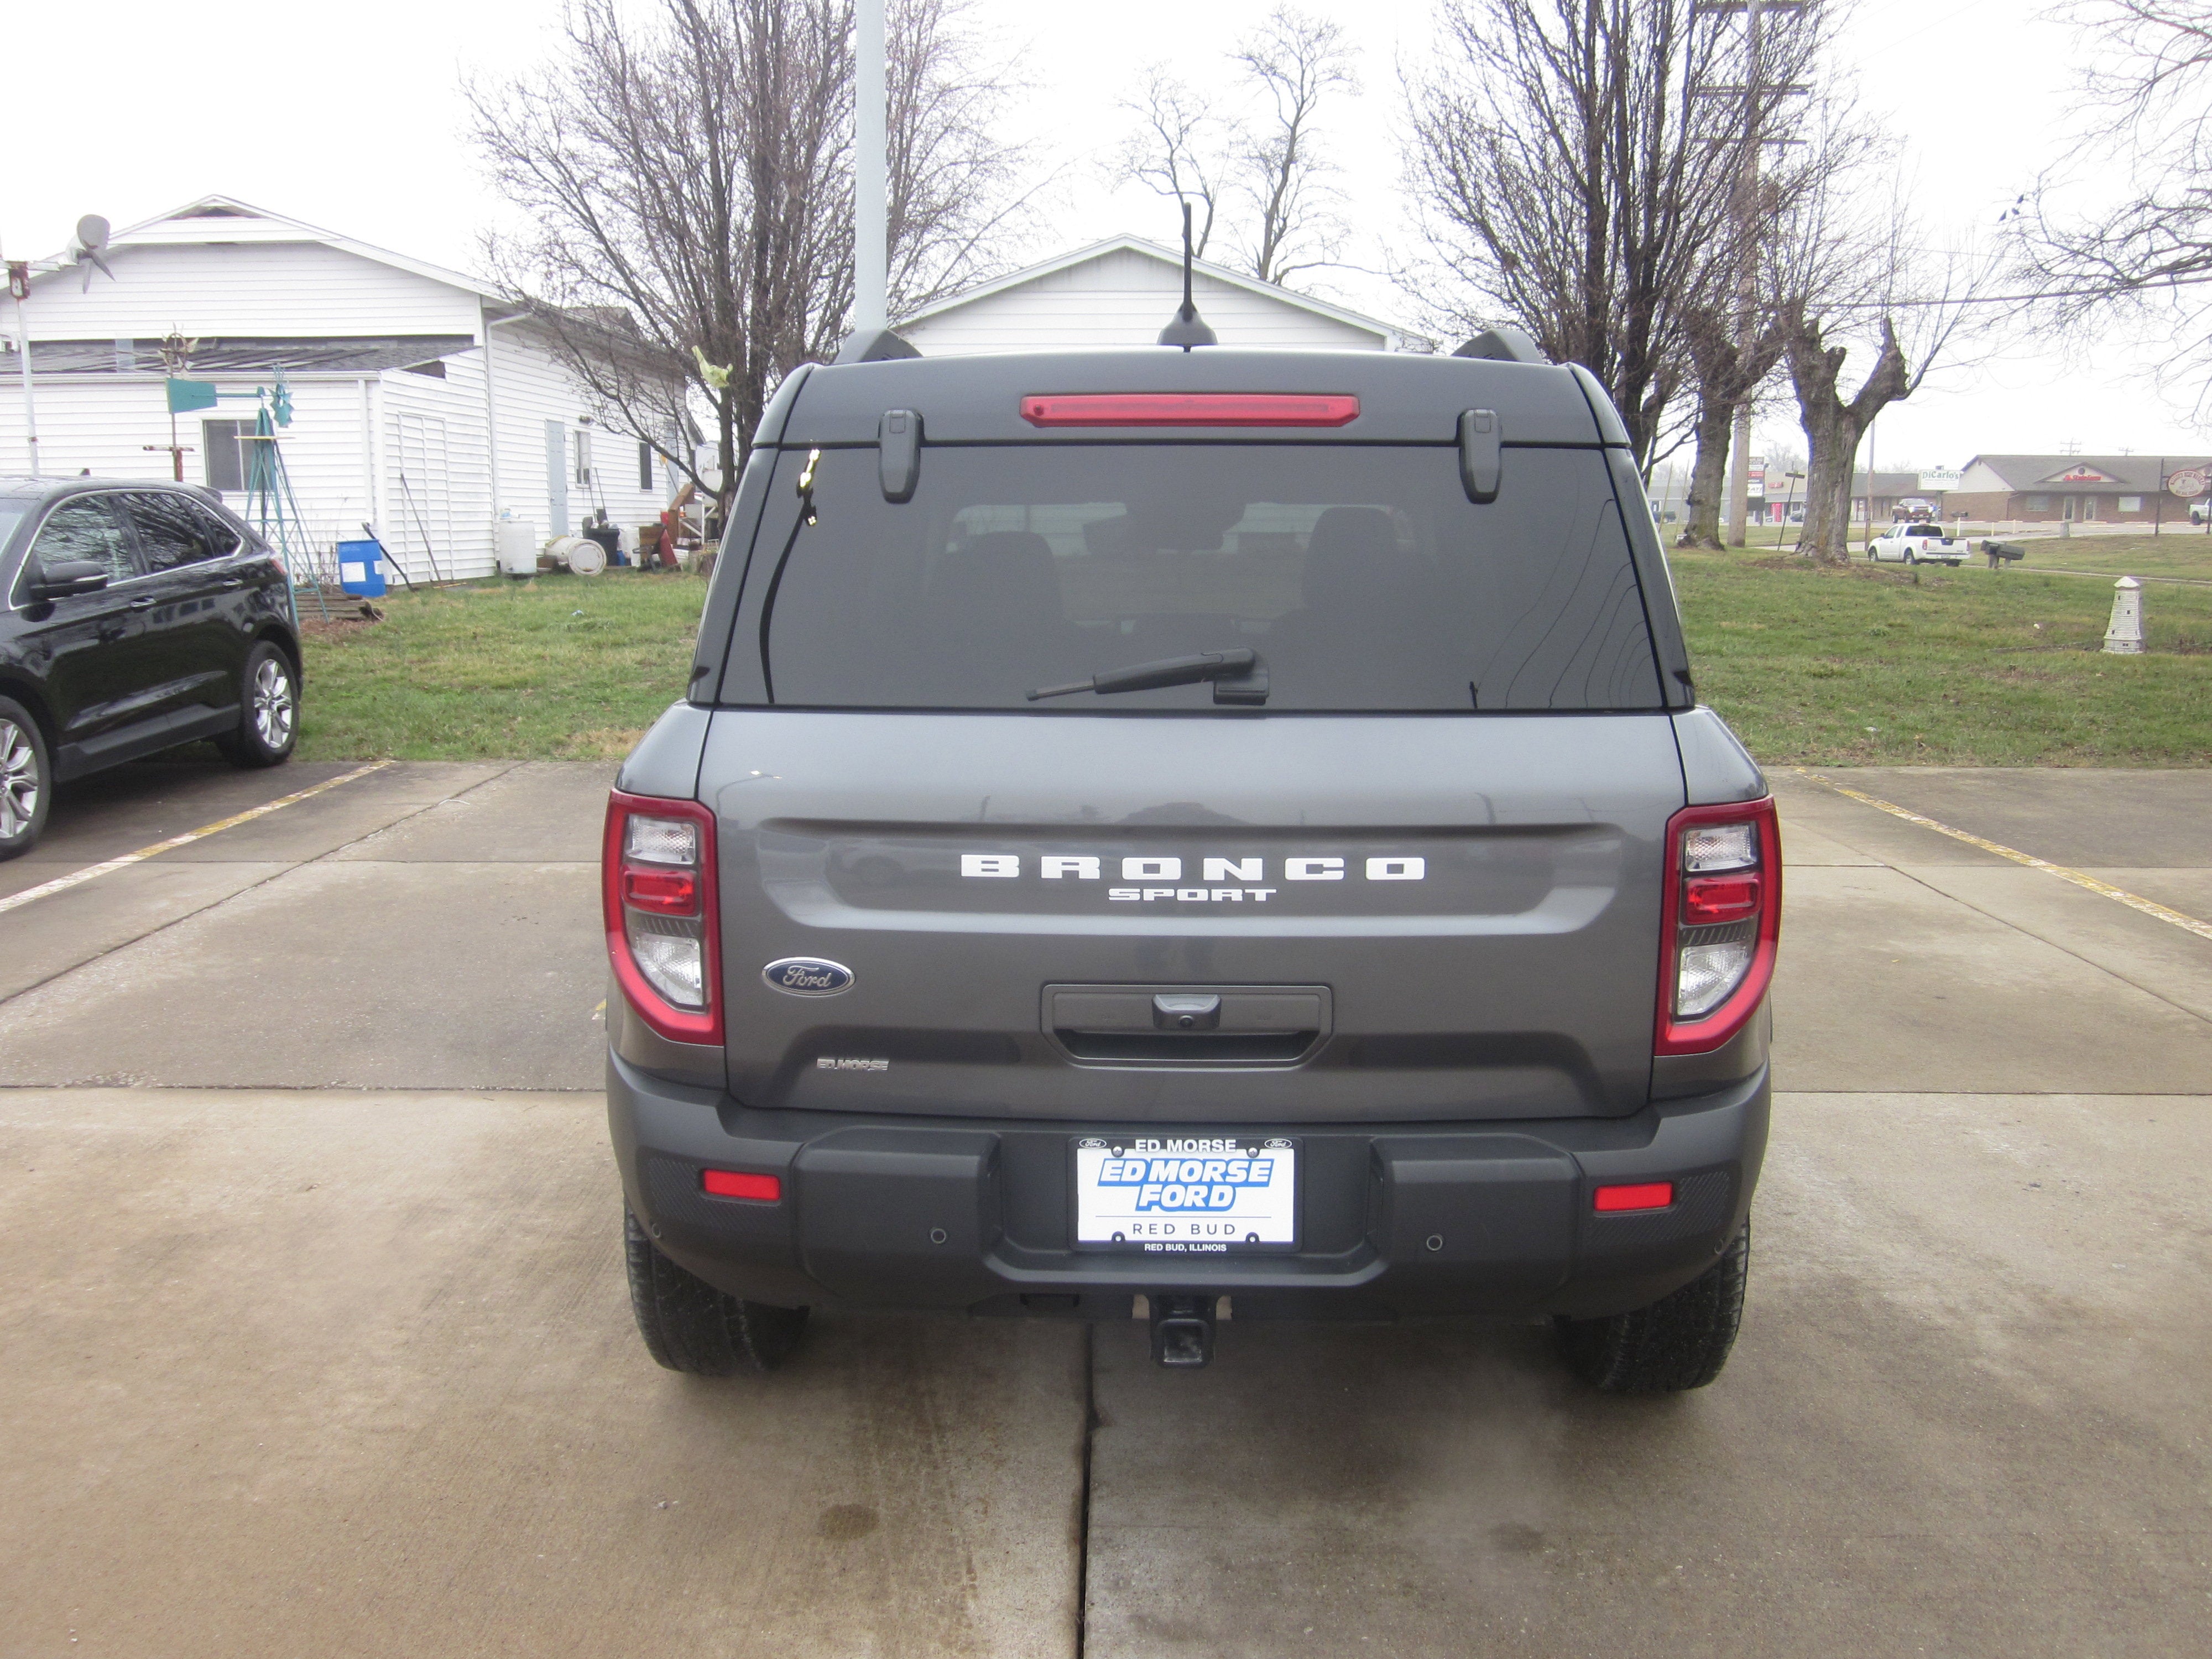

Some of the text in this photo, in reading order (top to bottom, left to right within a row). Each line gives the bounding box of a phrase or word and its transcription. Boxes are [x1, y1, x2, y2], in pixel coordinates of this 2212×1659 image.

[1922, 471, 1959, 479] DiCarlo's
[961, 854, 1425, 881] BRONCO
[1108, 888, 1277, 902] SPORT
[782, 965, 832, 987] Ford
[1135, 1139, 1237, 1152] ED MORSE
[1099, 1160, 1272, 1183] ED MORSE
[1138, 1183, 1234, 1208] FORD
[1133, 1223, 1235, 1235] RED BUD
[1144, 1243, 1164, 1251] RED
[1165, 1243, 1187, 1253] BUD,
